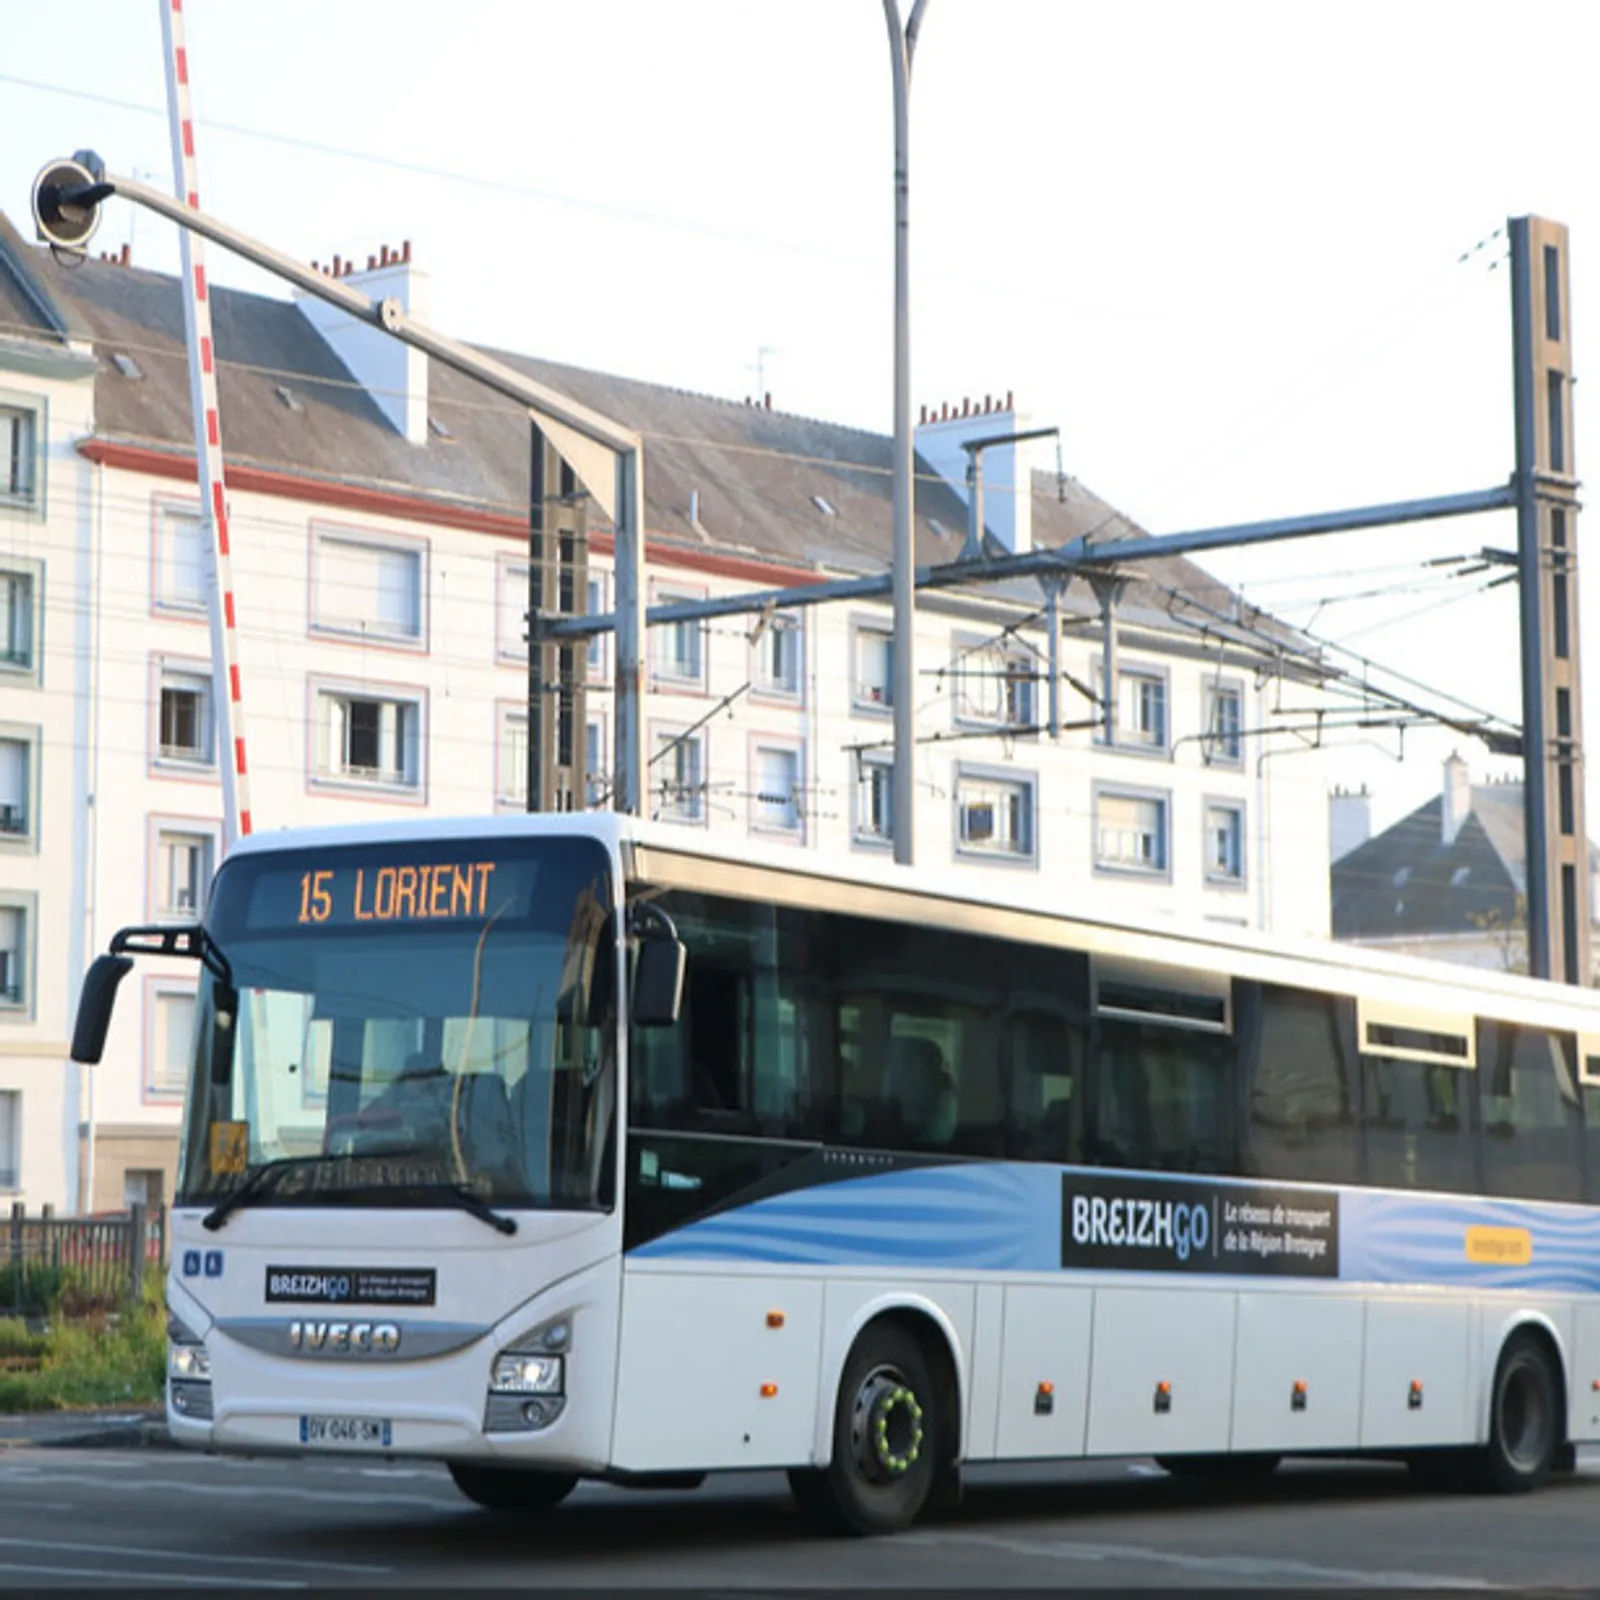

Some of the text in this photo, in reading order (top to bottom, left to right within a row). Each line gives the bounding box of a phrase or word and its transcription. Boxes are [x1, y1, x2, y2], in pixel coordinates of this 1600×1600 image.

[298, 862, 495, 924] 15 LORIENT
[1072, 1195, 1209, 1259] BREIZHGO
[1272, 1203, 1284, 1225] de
[1224, 1229, 1237, 1251] de
[270, 1274, 350, 1300] BREIZHGO
[290, 1321, 401, 1353] IVECO
